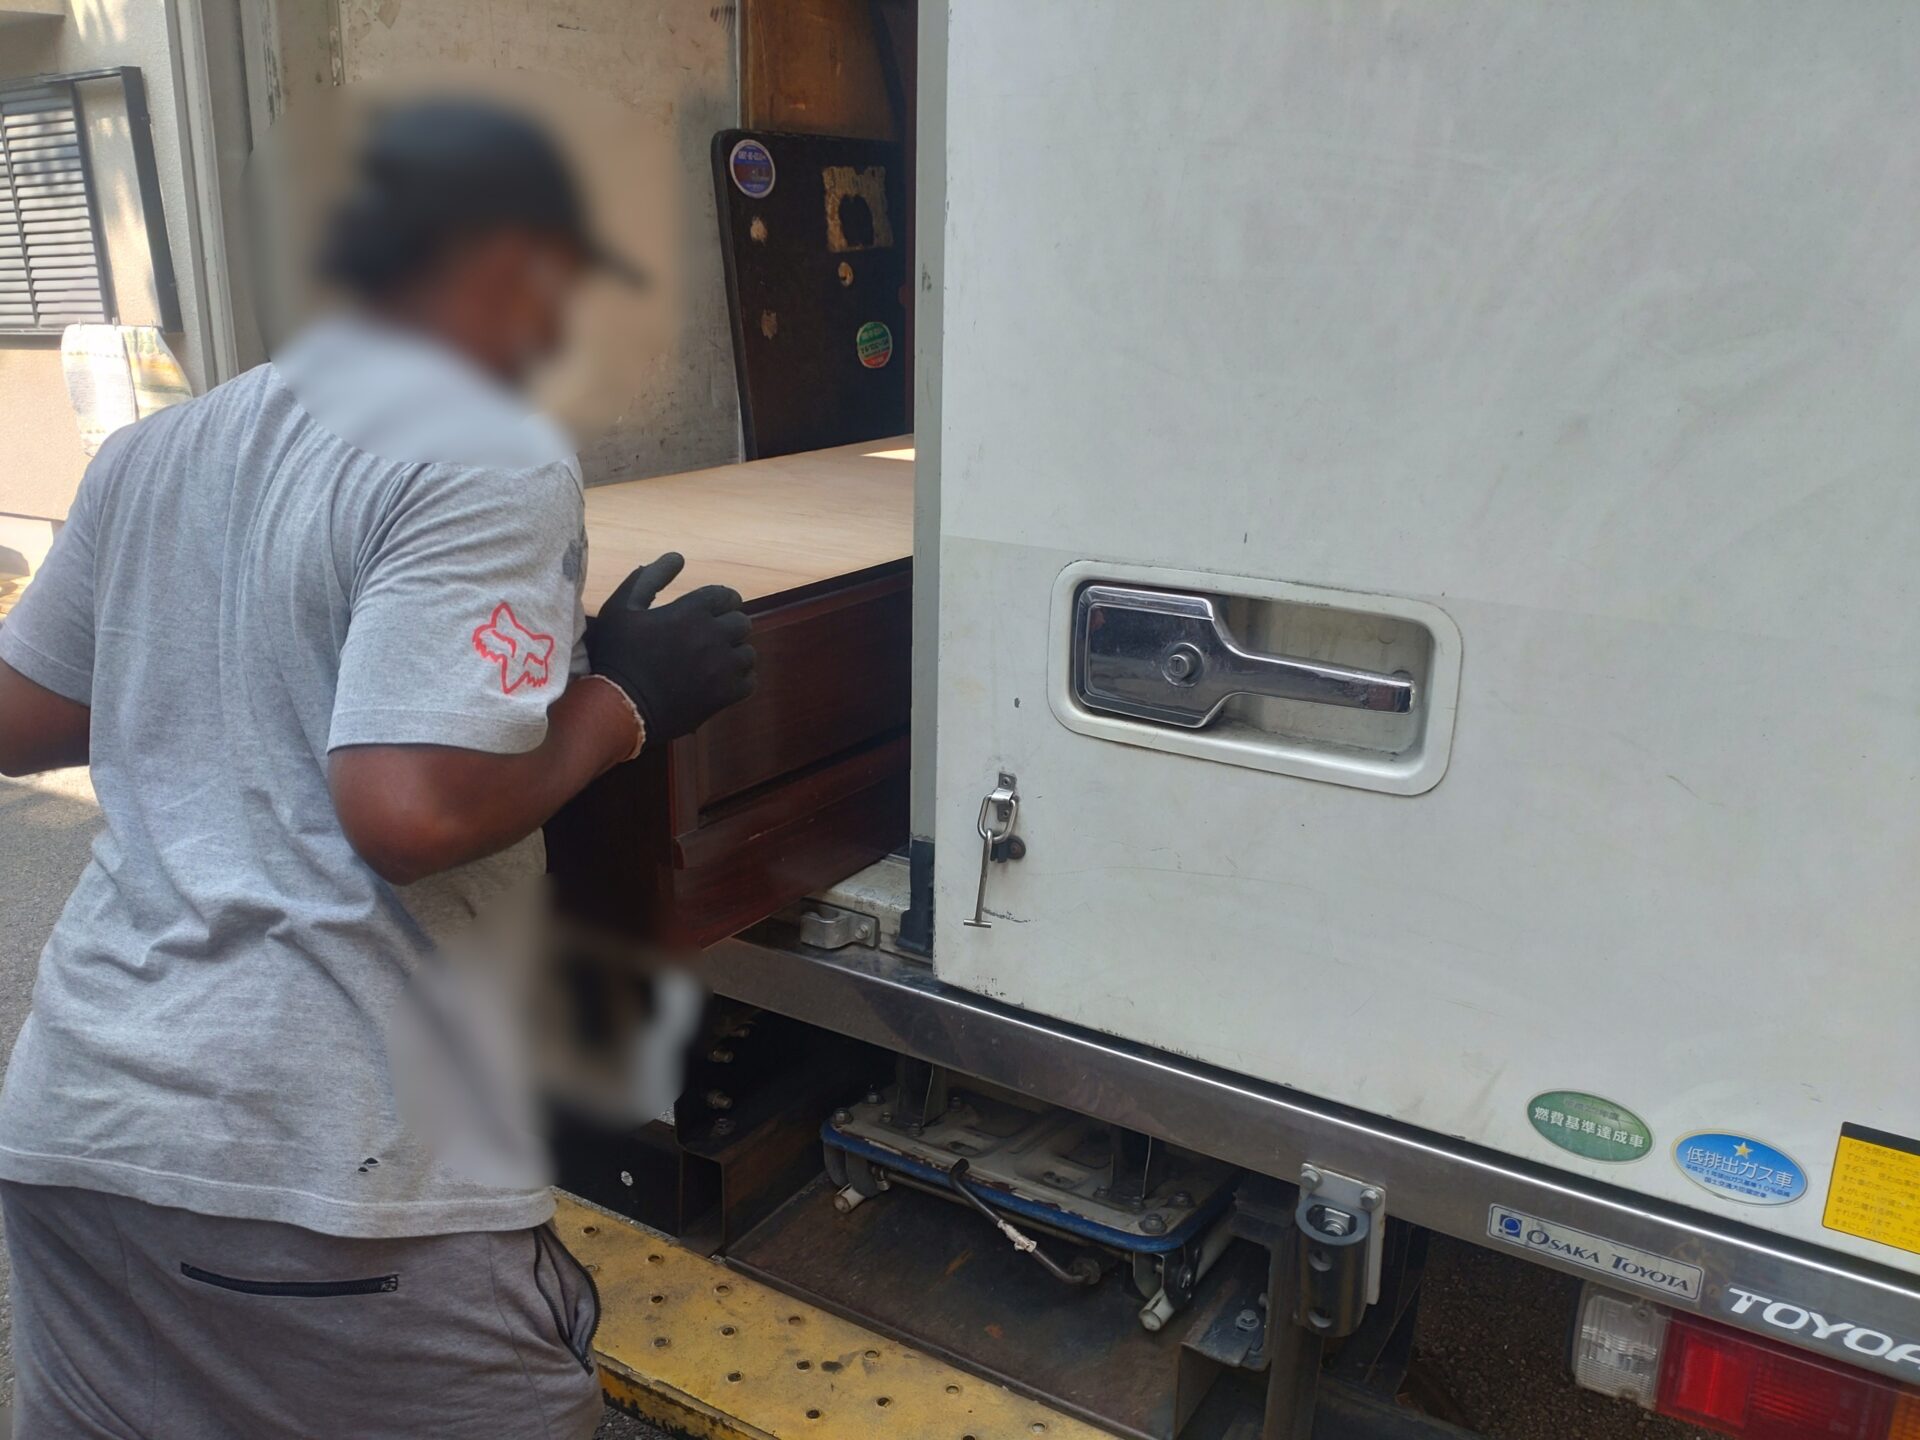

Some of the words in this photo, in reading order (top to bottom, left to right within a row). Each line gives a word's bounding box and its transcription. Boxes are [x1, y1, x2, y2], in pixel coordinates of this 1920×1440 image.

[1534, 1106, 1645, 1148] 燃費基準達成車
[1686, 1145, 1794, 1189] 低排出ガス車
[1526, 1229, 1600, 1264] OSAKA
[1611, 1254, 1689, 1292] TOYOTA
